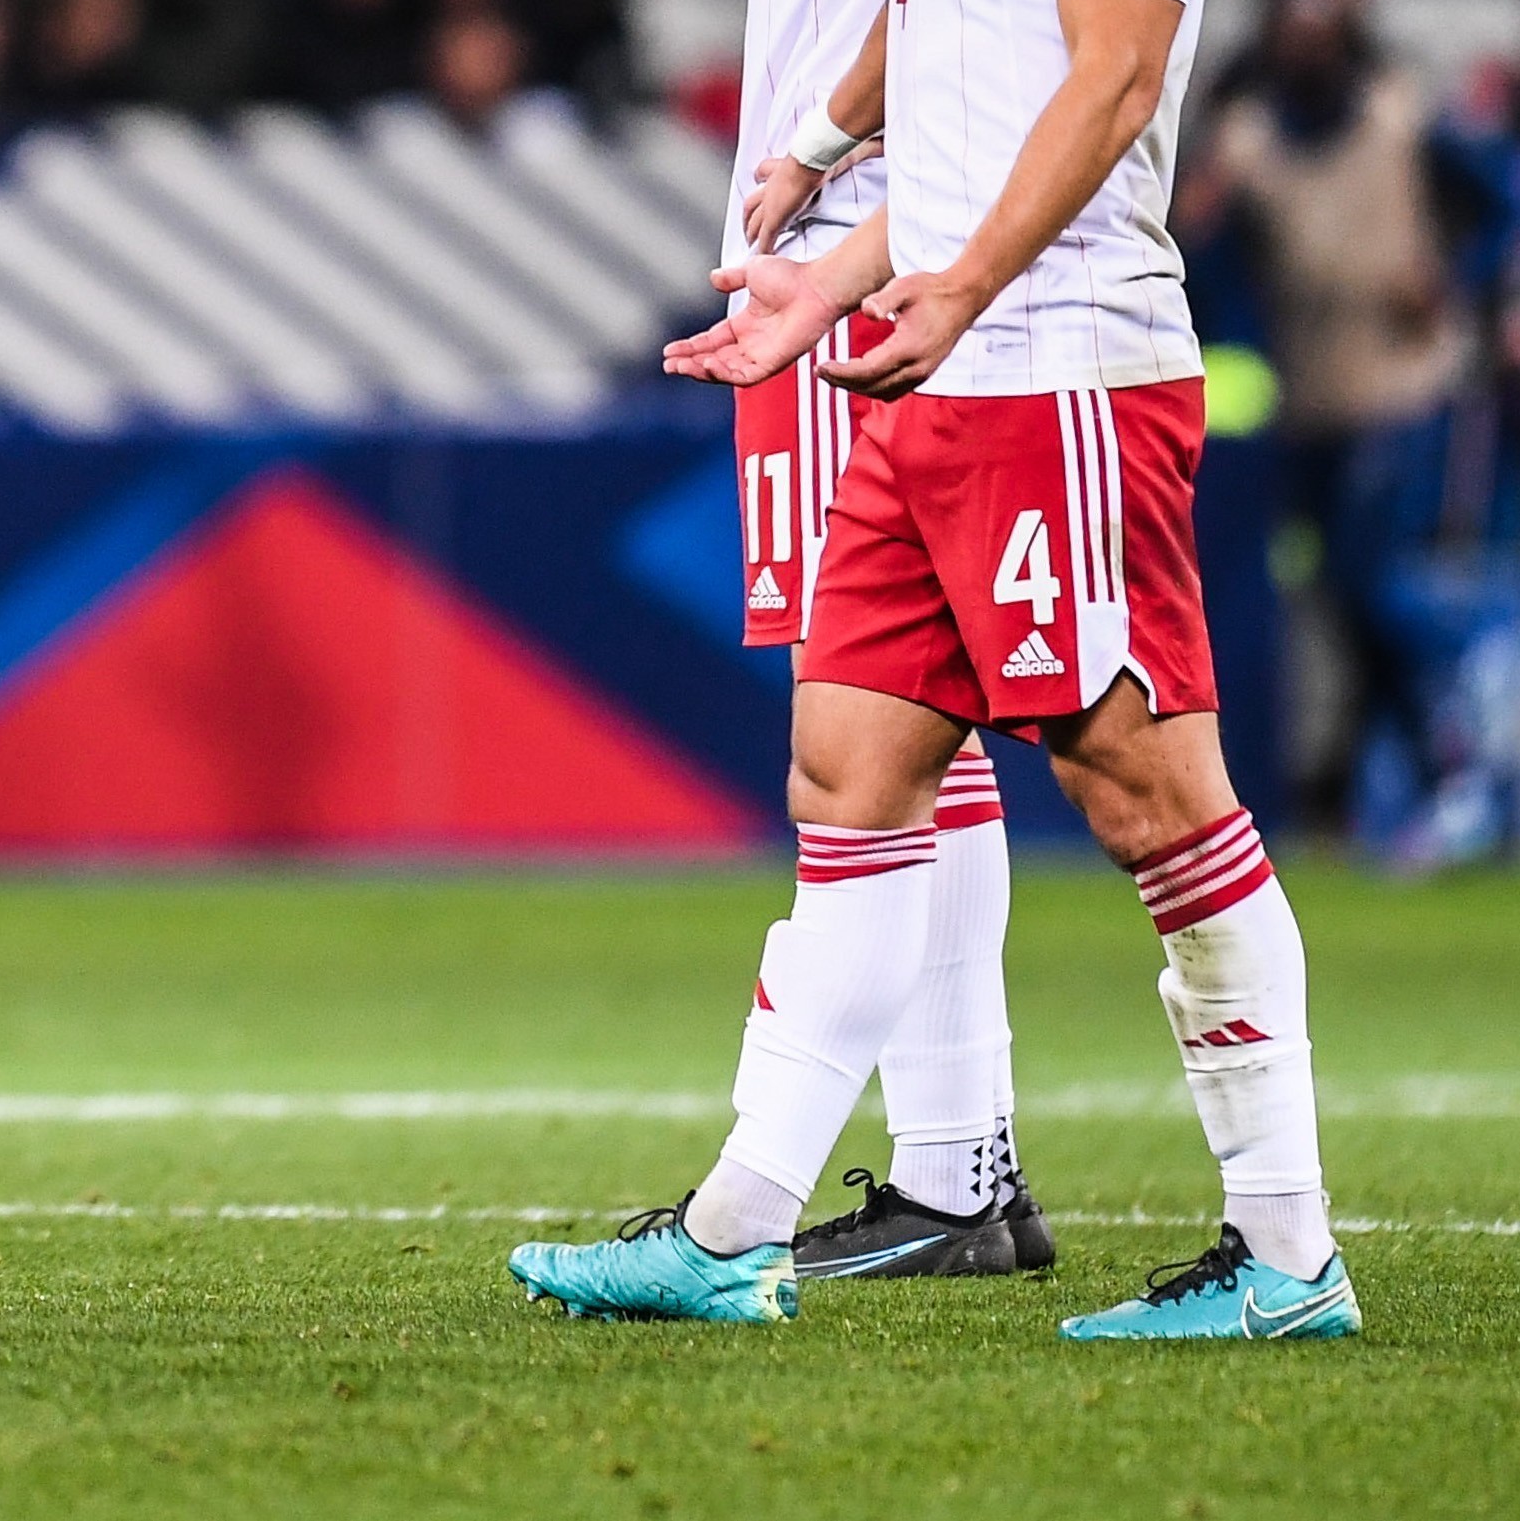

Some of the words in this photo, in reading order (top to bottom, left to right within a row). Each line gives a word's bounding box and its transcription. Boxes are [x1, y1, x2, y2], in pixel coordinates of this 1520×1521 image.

[744, 451, 791, 564] 11
[992, 509, 1061, 626] 4
[748, 593, 787, 610] adidas
[1001, 659, 1065, 678] adidas
